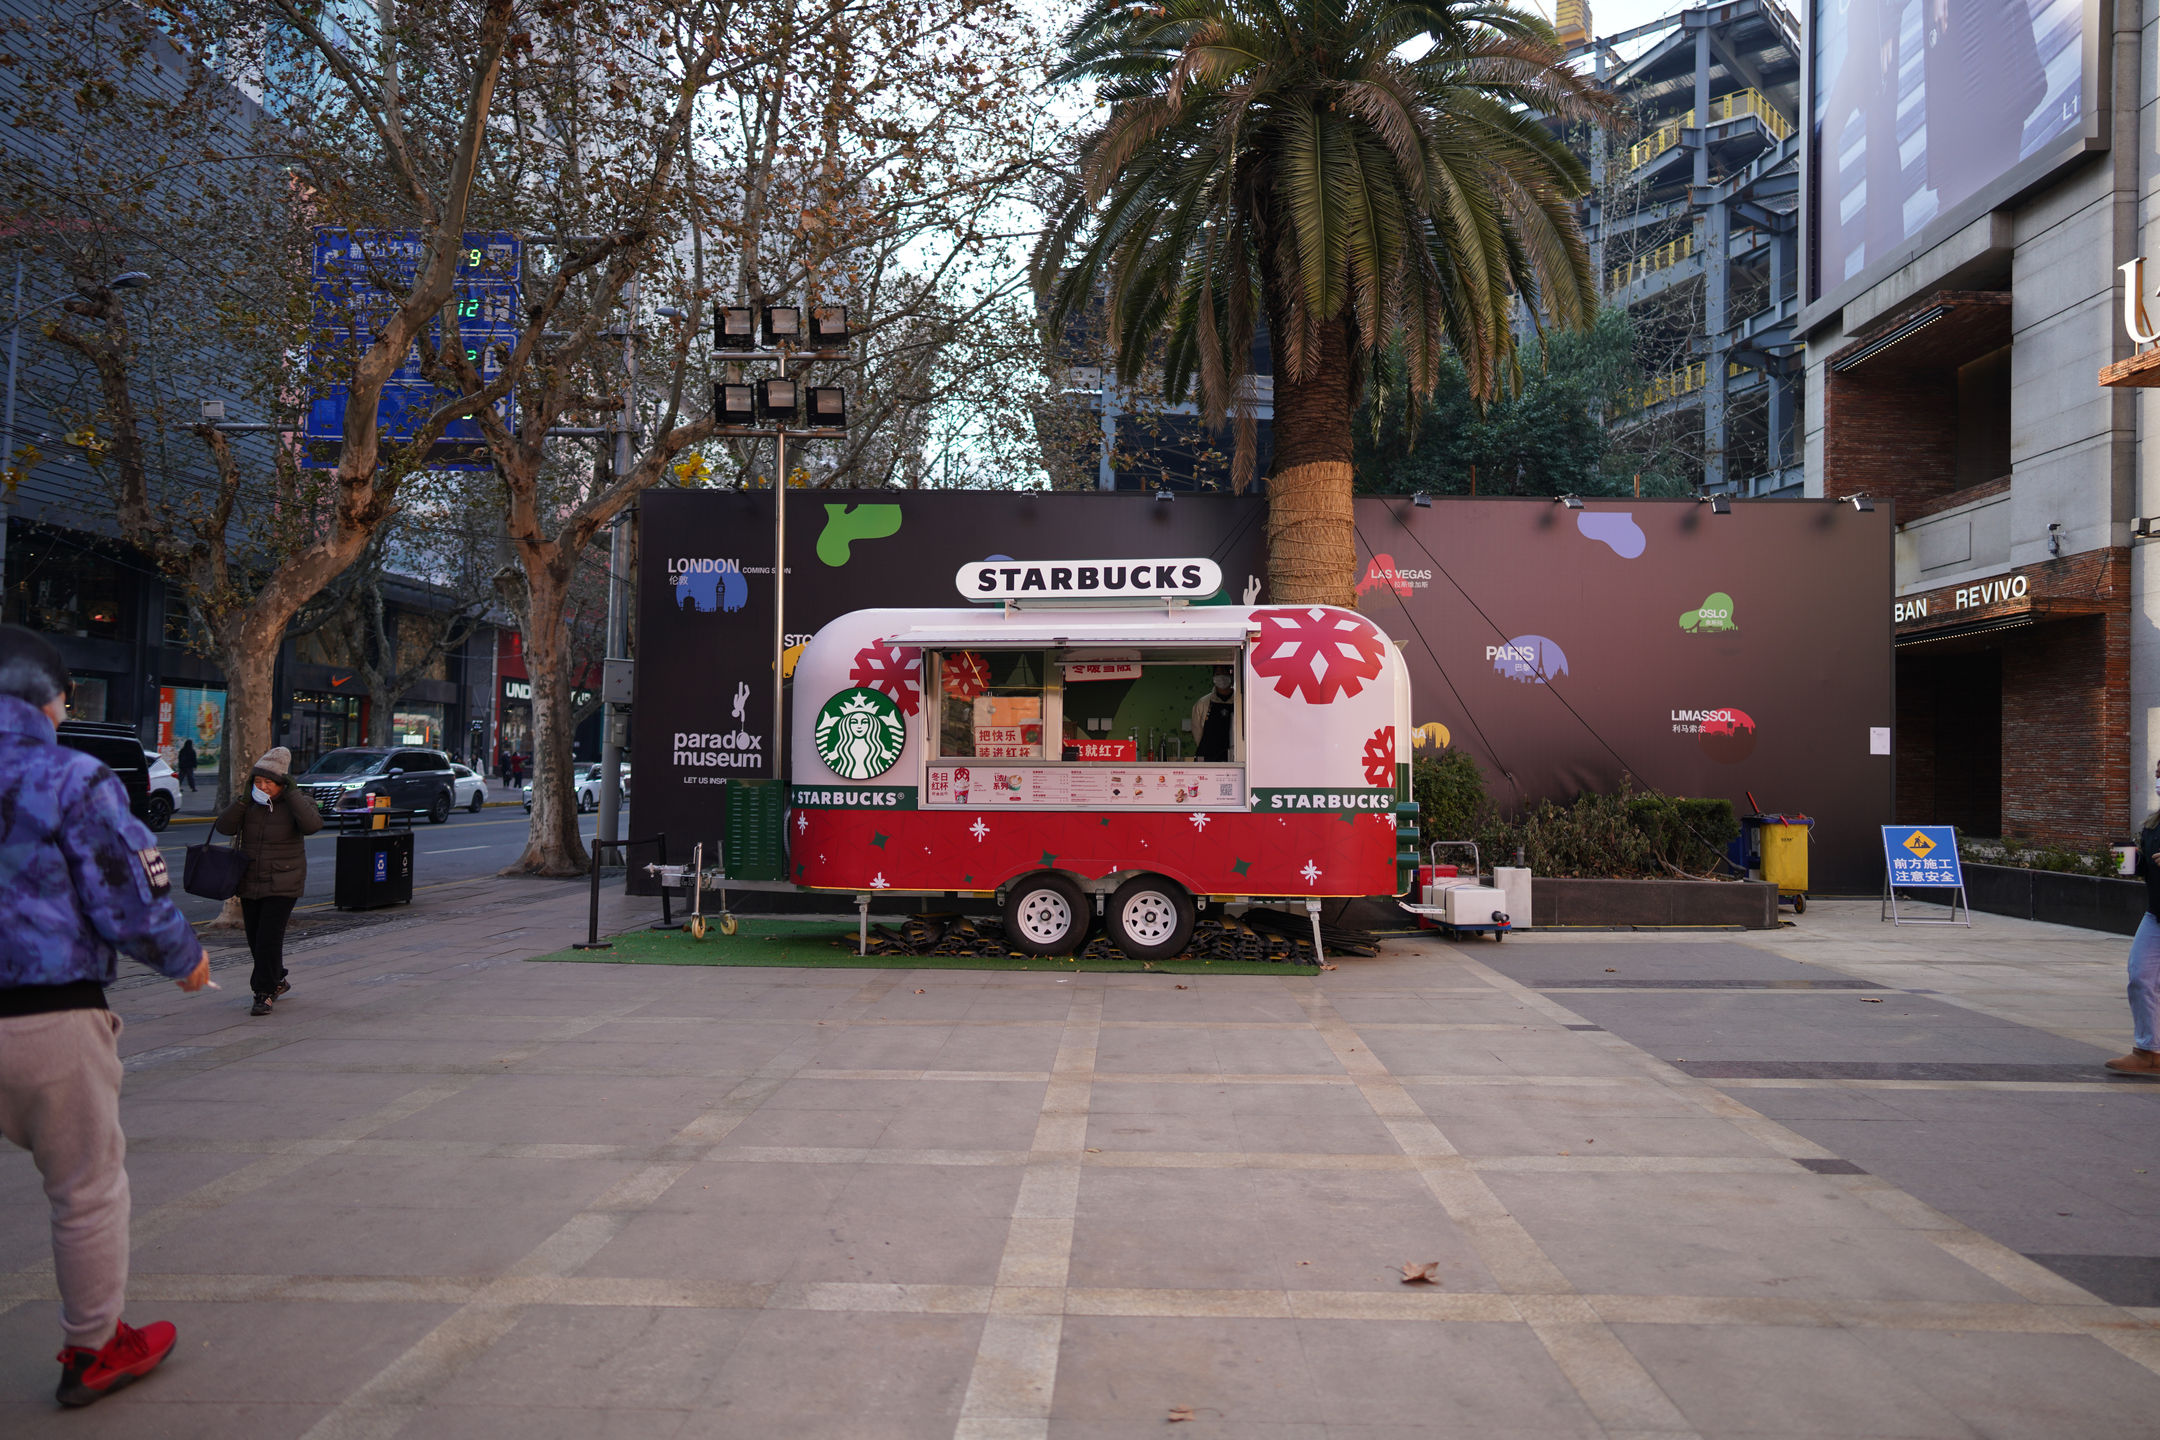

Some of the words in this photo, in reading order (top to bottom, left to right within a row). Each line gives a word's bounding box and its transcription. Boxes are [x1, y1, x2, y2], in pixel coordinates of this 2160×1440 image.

[458, 298, 479, 317] 12
[667, 557, 740, 574] LONDON
[742, 566, 770, 575] COMING
[668, 575, 689, 586] 伦敦
[977, 564, 1202, 592] STARBUCKS
[1370, 568, 1393, 580] LAS
[1394, 569, 1432, 580] VEGAS
[1955, 575, 2028, 611] REVIVO
[1698, 608, 1728, 619] OSLO
[1485, 645, 1535, 661] PARIS
[1671, 709, 1736, 722] LIMASSOL
[1671, 723, 1706, 734] 利马索尔
[674, 730, 762, 750] paradox
[979, 729, 1016, 742] 把快乐
[673, 750, 762, 768] museum
[683, 776, 698, 784] LET
[698, 777, 709, 785] US
[931, 772, 949, 782] 冬日
[1893, 858, 1953, 870] 前方施工
[1895, 870, 1955, 882] 注意安全
